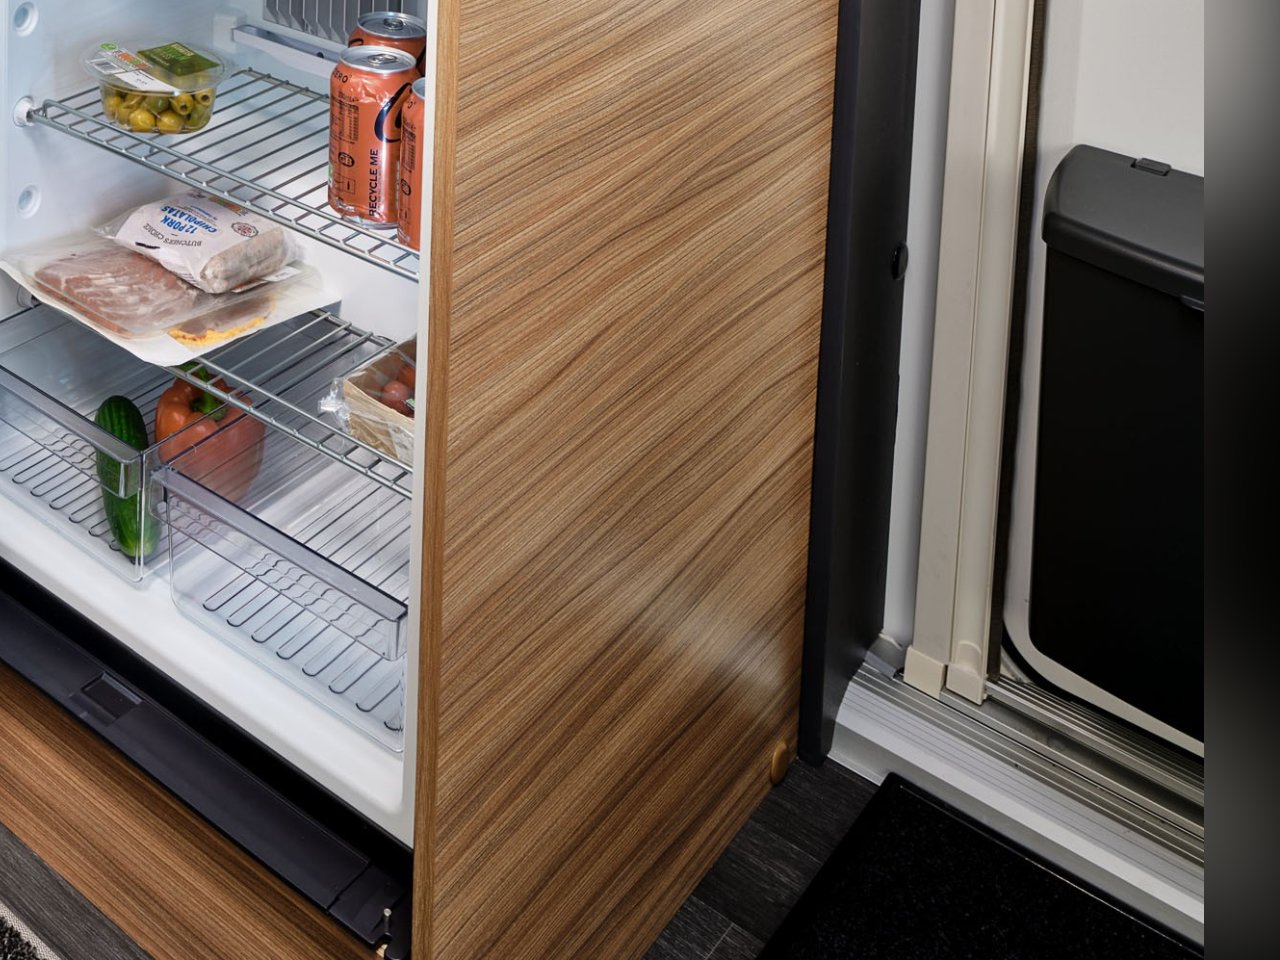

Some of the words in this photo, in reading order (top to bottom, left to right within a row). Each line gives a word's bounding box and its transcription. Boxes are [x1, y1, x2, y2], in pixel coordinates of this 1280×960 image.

[370, 149, 378, 165] ME
[369, 168, 378, 216] RECYCLE
[161, 215, 186, 232] PORK
[162, 205, 217, 233] CHIPOLATAS
